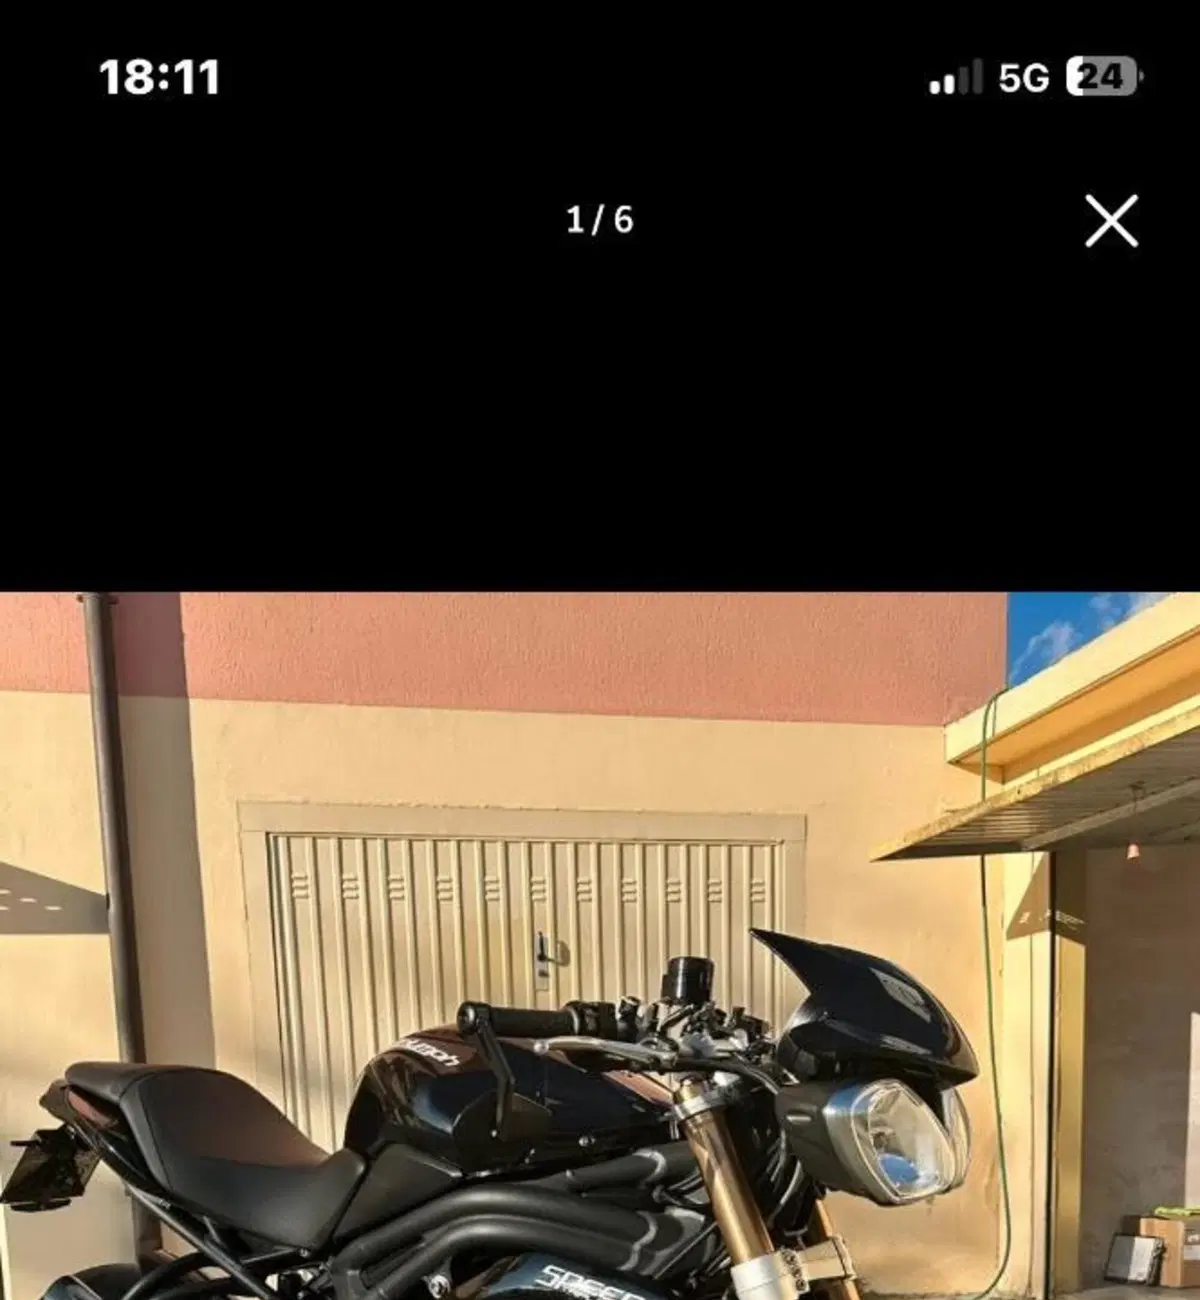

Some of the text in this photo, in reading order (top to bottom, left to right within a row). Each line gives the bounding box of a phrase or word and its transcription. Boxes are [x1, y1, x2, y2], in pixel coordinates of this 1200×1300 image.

[99, 58, 218, 95] 18:11
[999, 62, 1050, 93] 5G
[1078, 62, 1125, 91] 24
